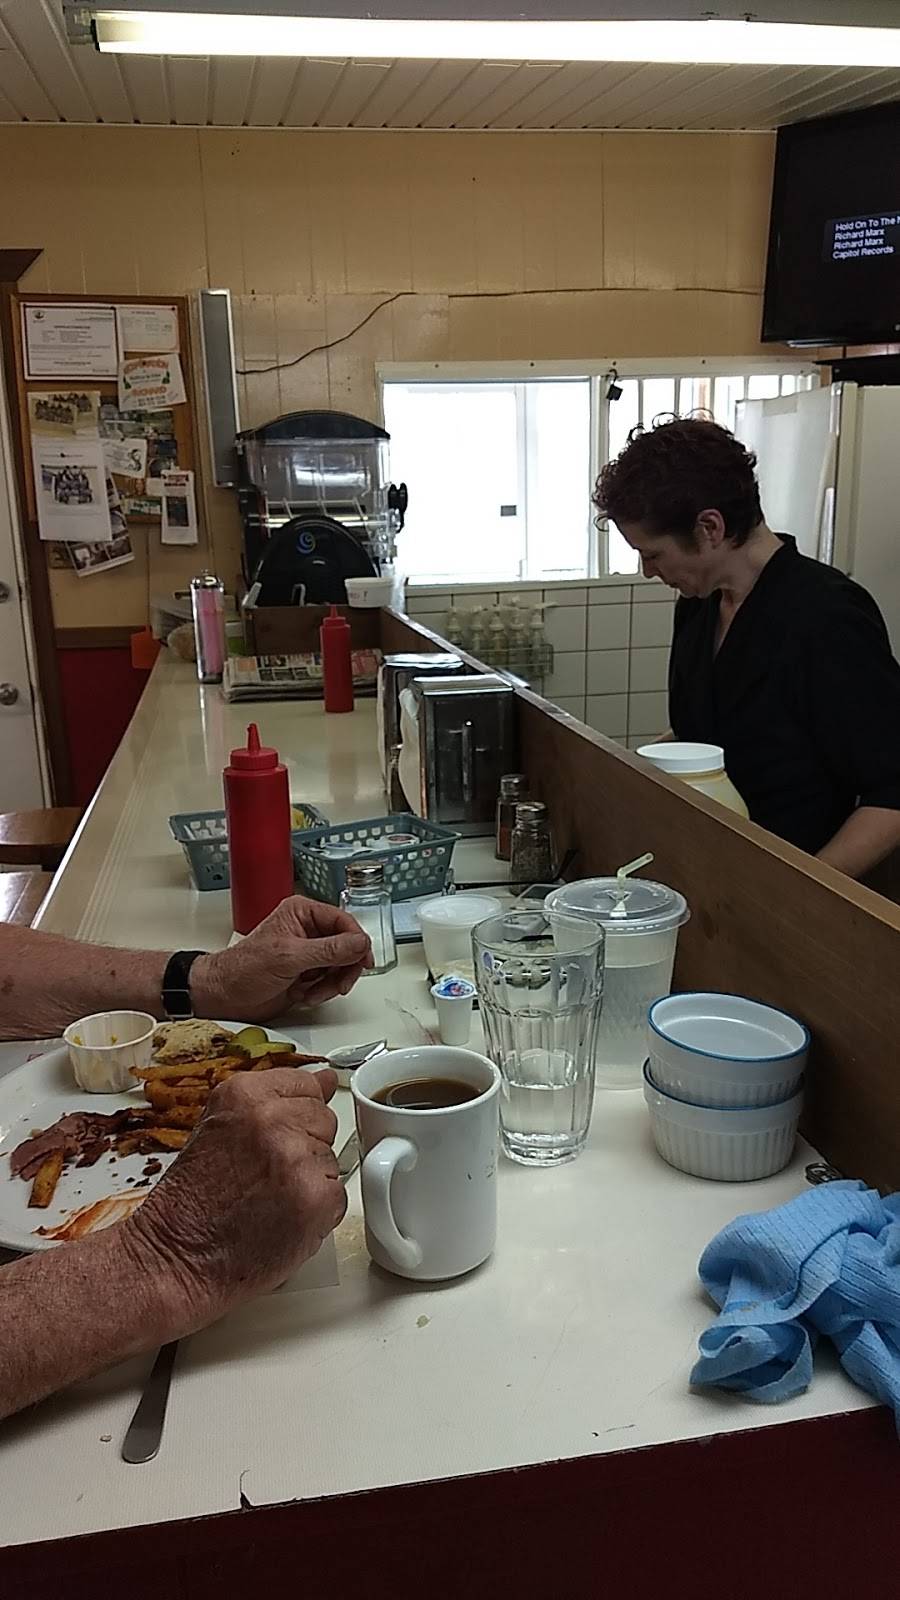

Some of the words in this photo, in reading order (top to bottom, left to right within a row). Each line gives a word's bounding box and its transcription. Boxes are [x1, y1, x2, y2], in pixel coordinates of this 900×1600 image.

[835, 221, 854, 231] Hold
[855, 221, 867, 229] On
[868, 219, 879, 227] To
[880, 217, 896, 226] The
[834, 230, 864, 240] Richard
[865, 229, 885, 237] Marx
[833, 239, 864, 250] Richard
[864, 238, 884, 246] Marx
[832, 249, 860, 260] Capitol
[861, 246, 894, 255] Records
